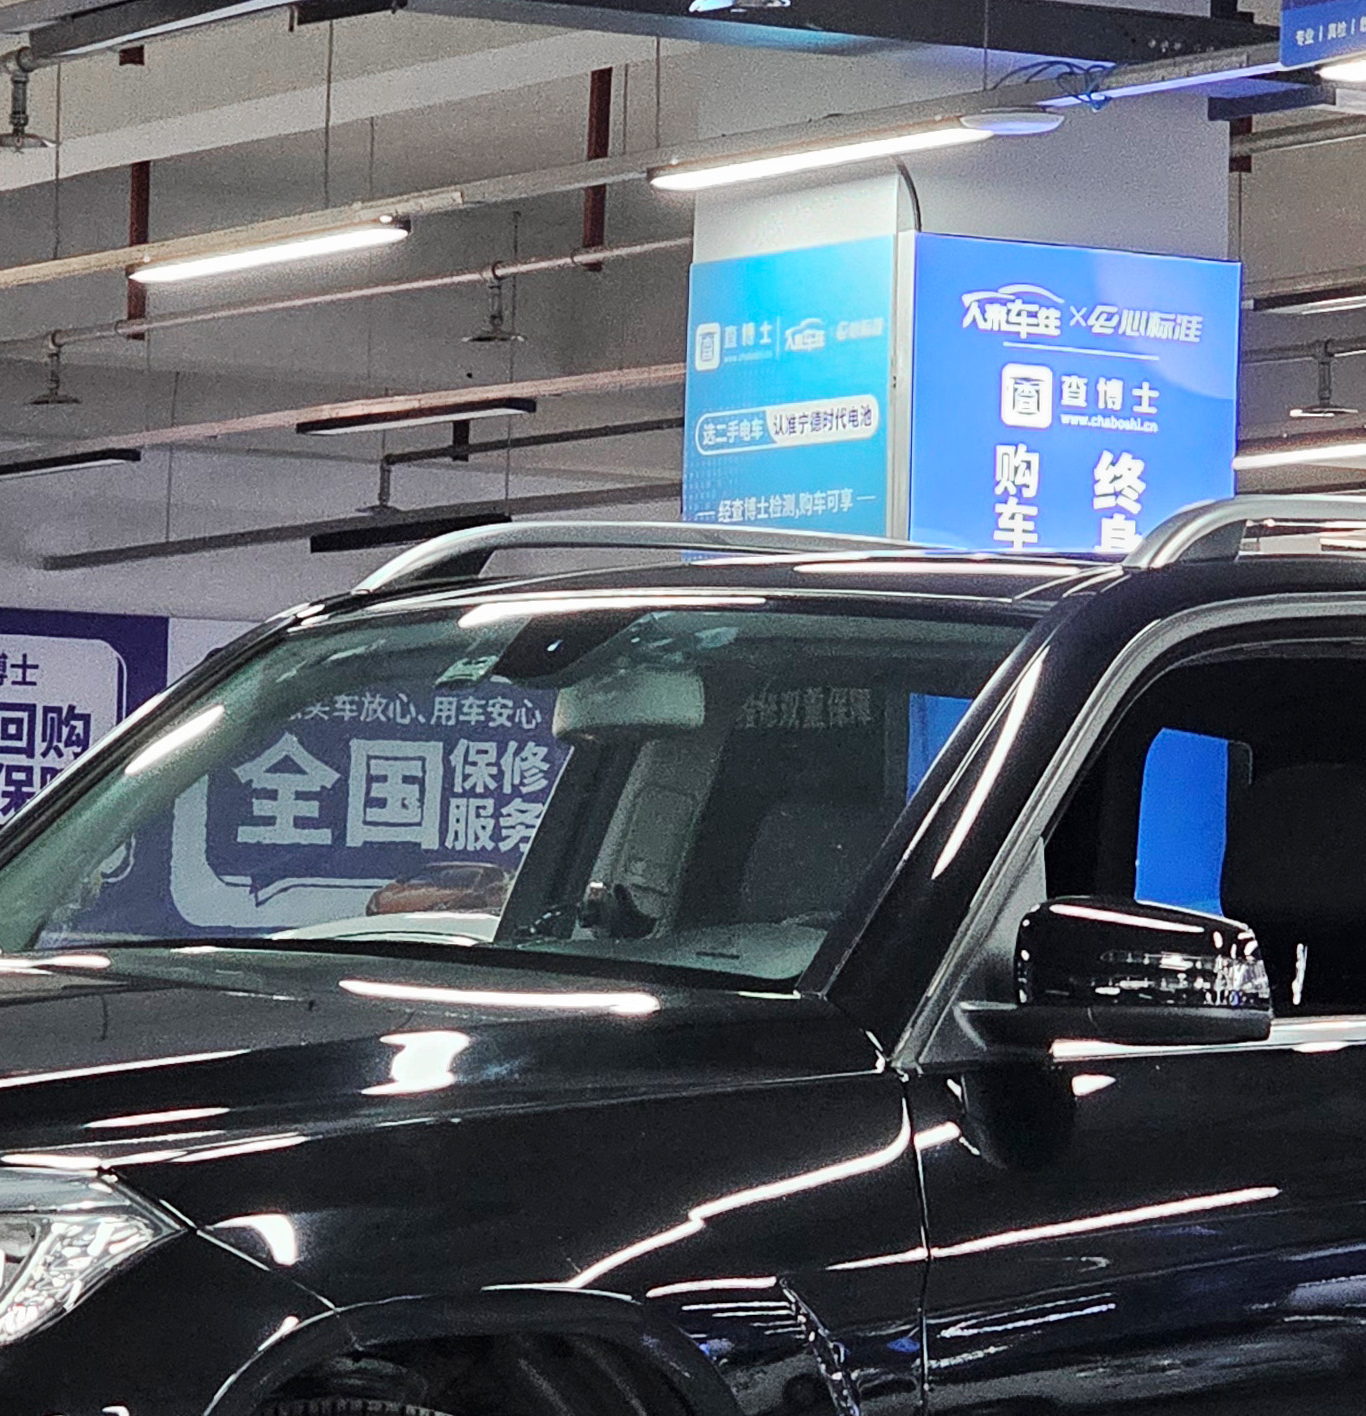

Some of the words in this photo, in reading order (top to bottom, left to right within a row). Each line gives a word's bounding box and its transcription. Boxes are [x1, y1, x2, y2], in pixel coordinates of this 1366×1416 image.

[1060, 375, 1160, 415] 查博士
[773, 405, 874, 436] 认准宁德时代电池
[235, 730, 445, 850] 全国
[449, 738, 552, 794] 保修
